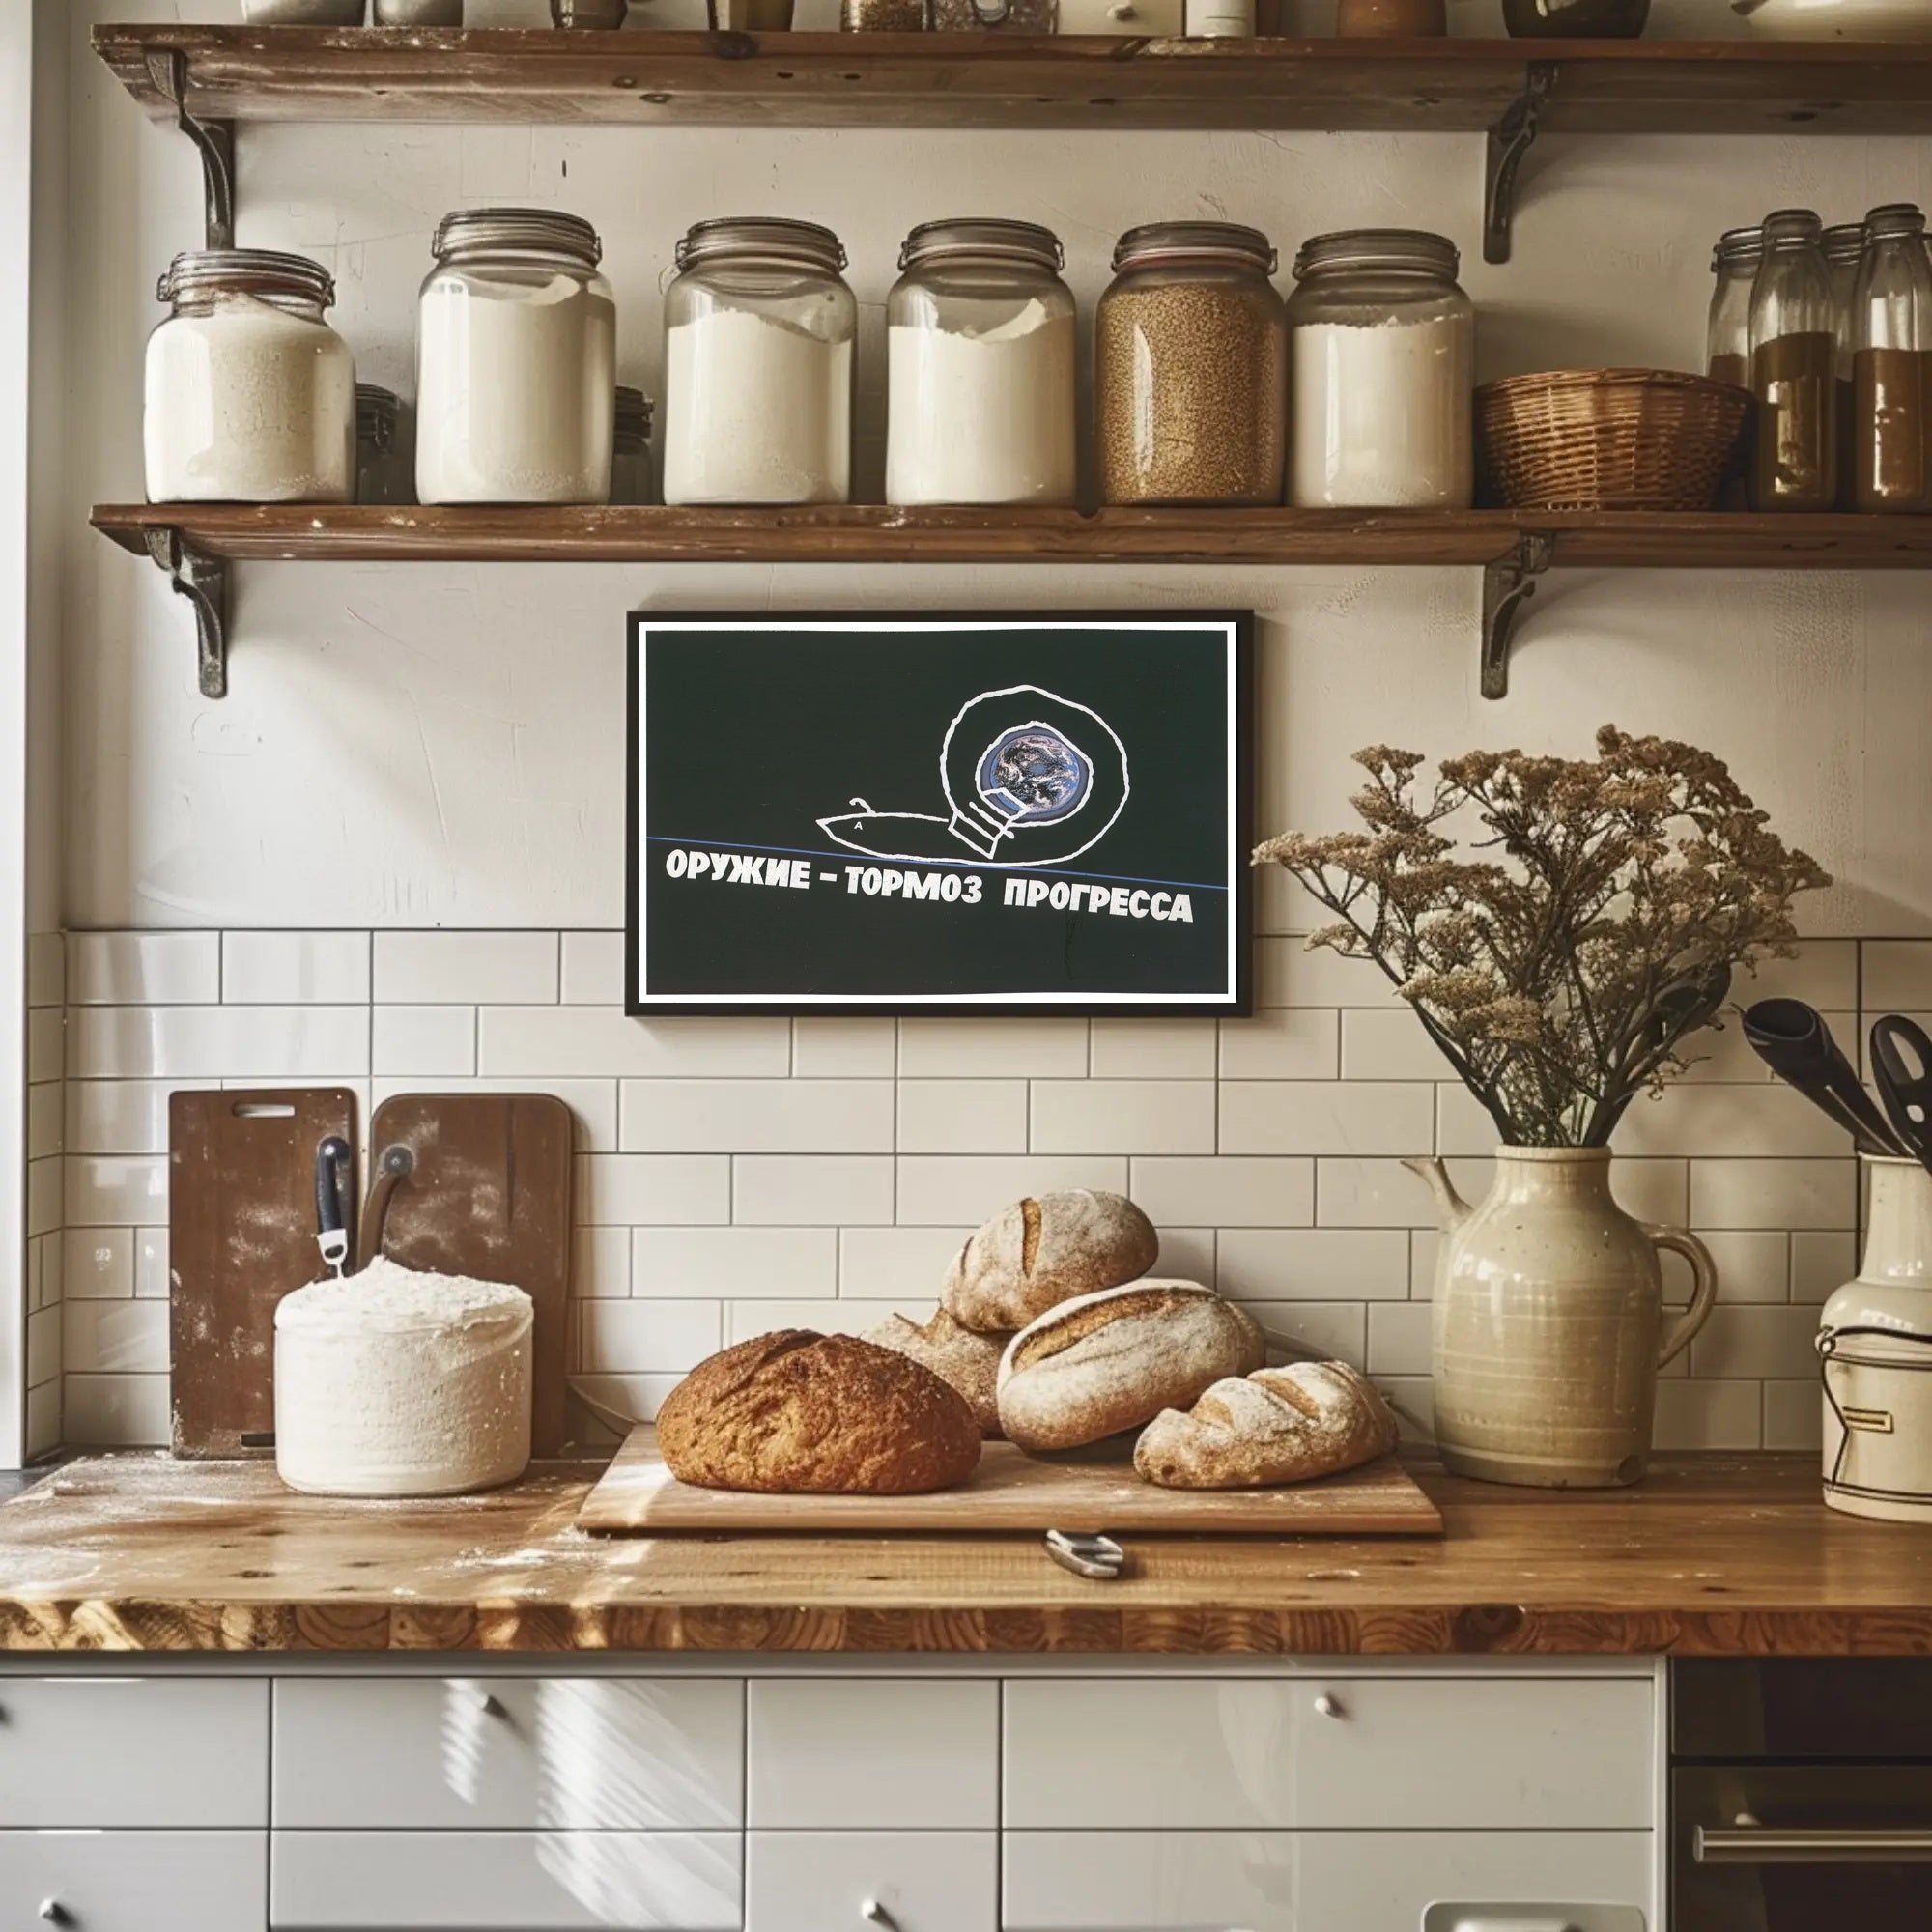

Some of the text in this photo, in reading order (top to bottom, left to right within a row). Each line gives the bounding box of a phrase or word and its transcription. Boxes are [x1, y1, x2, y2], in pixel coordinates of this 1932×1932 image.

[665, 848, 811, 889] ОРУЖИЕ
[844, 865, 983, 904] ТОРМОЗ
[1003, 877, 1194, 923] ПРОГРЕССА
